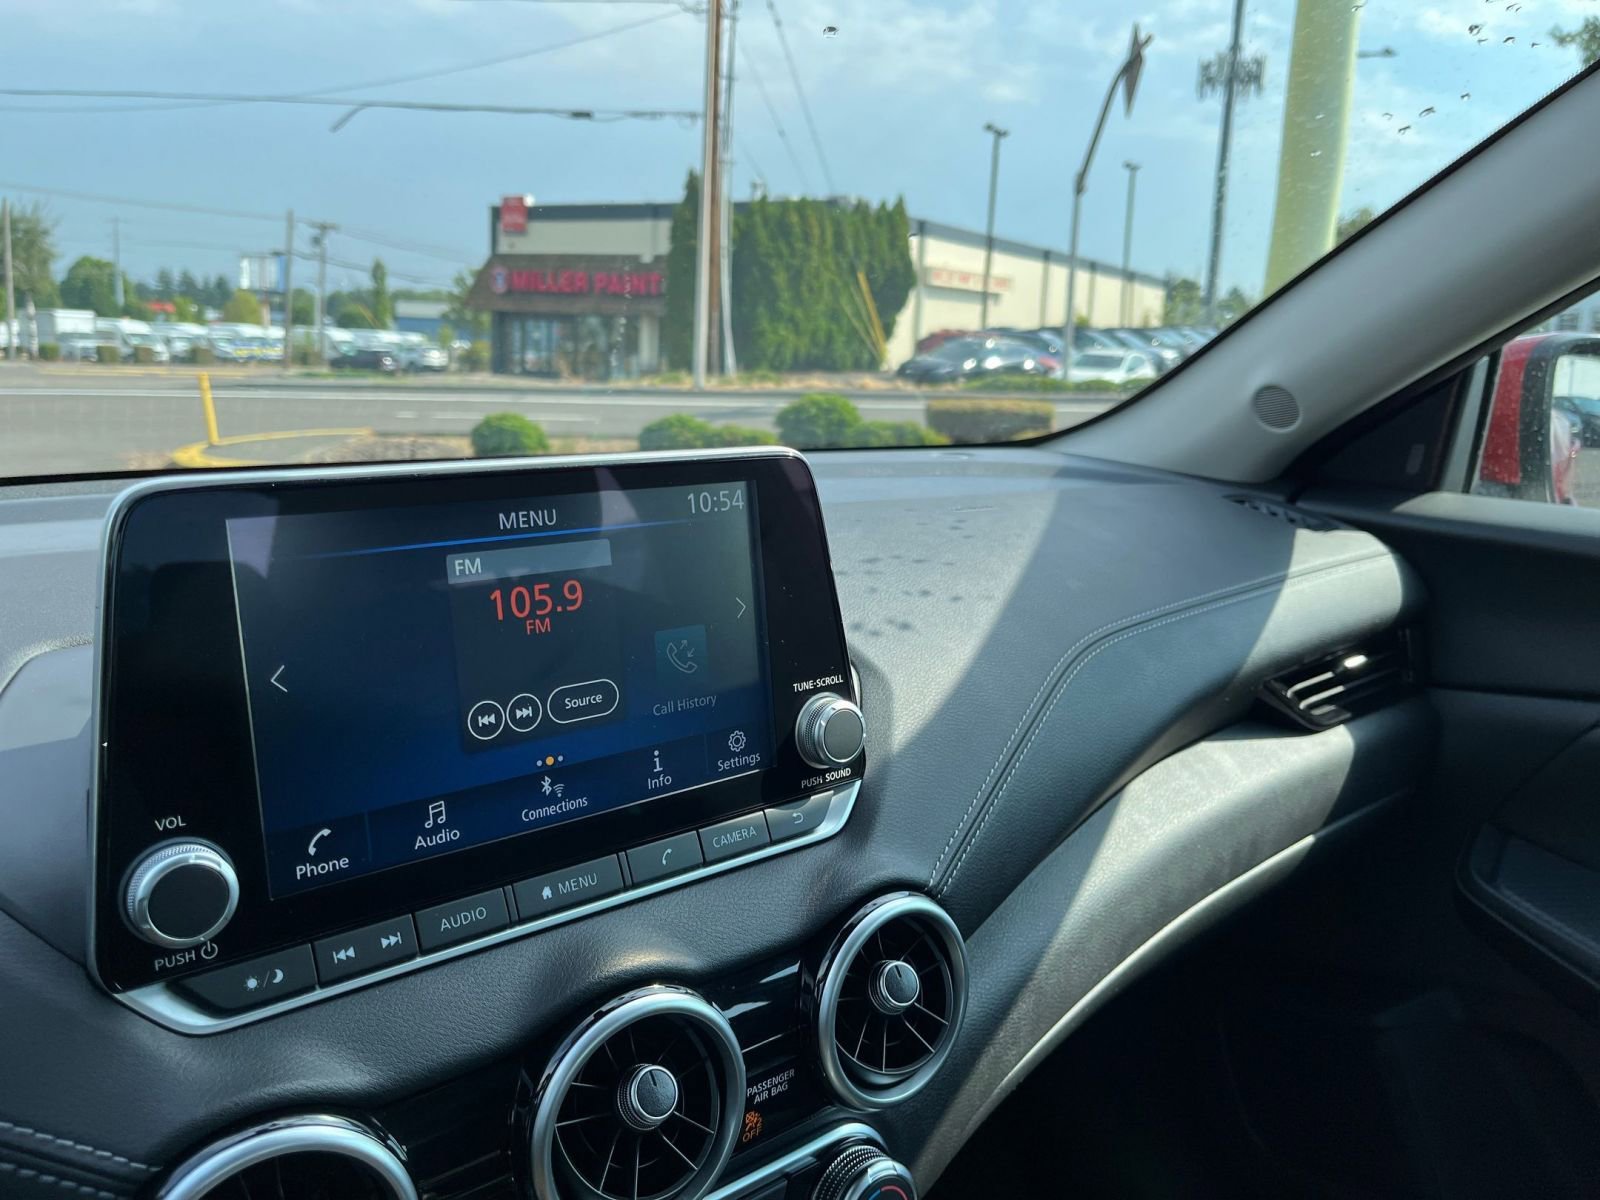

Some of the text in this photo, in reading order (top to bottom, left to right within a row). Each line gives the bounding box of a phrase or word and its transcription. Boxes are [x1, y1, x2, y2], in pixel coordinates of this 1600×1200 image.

[511, 270, 589, 294] MILLER
[687, 489, 745, 515] 10:54
[498, 508, 558, 530] MENU
[454, 557, 482, 576] FM
[490, 579, 583, 622] 105.9
[526, 617, 551, 636] FM
[564, 692, 603, 709] Source
[653, 693, 718, 717] Call History
[718, 751, 761, 772] Settings
[648, 773, 672, 790] Info
[801, 768, 851, 789] PUSH SOUND
[521, 795, 588, 822] Connections
[155, 815, 187, 832] VOL
[414, 828, 460, 850] Audio
[713, 826, 757, 849] CAMERA
[296, 855, 349, 880] Phone
[558, 872, 598, 895] MENU
[440, 906, 487, 932] AUDIO
[154, 950, 196, 972] PUSH
[746, 1068, 795, 1097] PASSENGER
[754, 1082, 788, 1105] AIR BAG
[742, 1127, 762, 1143] OFF
